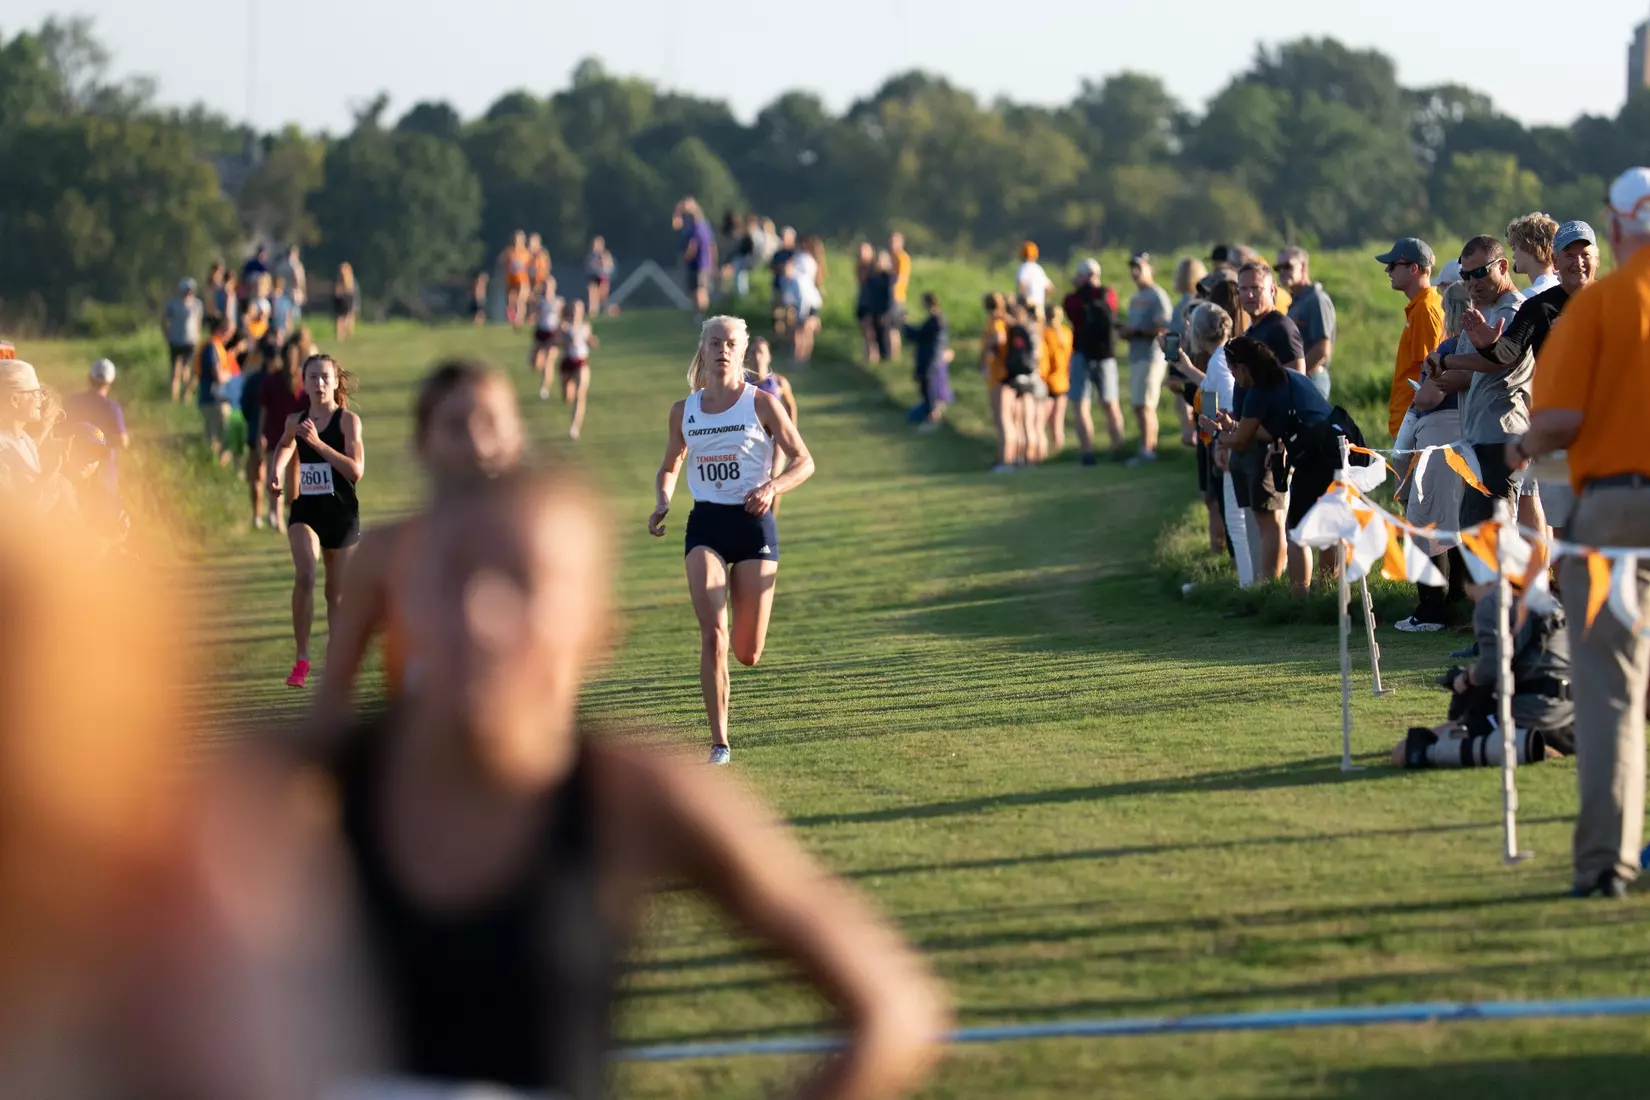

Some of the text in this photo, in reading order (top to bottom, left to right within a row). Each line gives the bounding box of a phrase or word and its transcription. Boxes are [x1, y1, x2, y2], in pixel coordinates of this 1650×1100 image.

[688, 424, 745, 436] CHATTANOOGA
[696, 454, 737, 462] TENNESSEE
[301, 470, 330, 484] 1092
[698, 462, 740, 481] 1008
